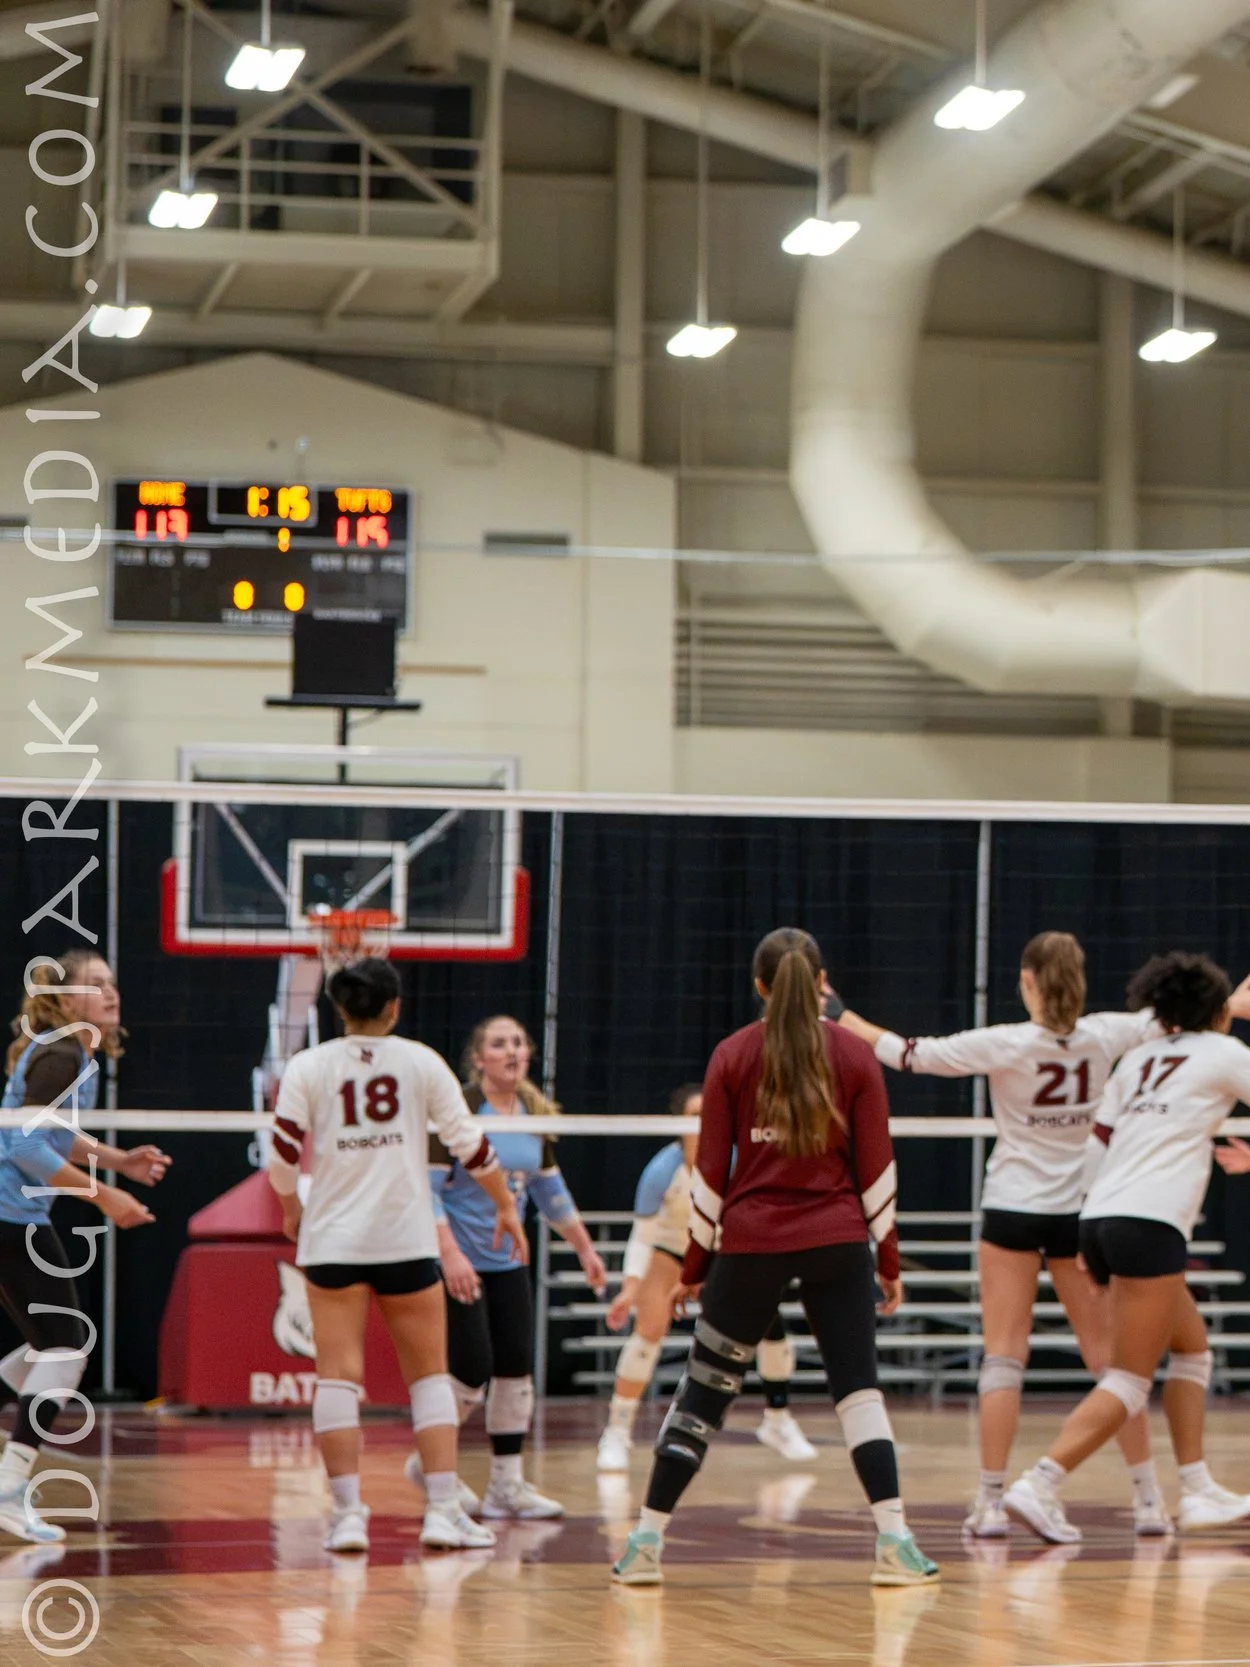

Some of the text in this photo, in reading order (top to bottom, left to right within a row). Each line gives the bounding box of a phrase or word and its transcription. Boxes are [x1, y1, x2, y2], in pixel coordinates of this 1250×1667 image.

[1033, 1058, 1089, 1107] 21
[1133, 1055, 1190, 1097] 17
[337, 1075, 400, 1127] 18
[336, 1133, 404, 1151] BOBCATS
